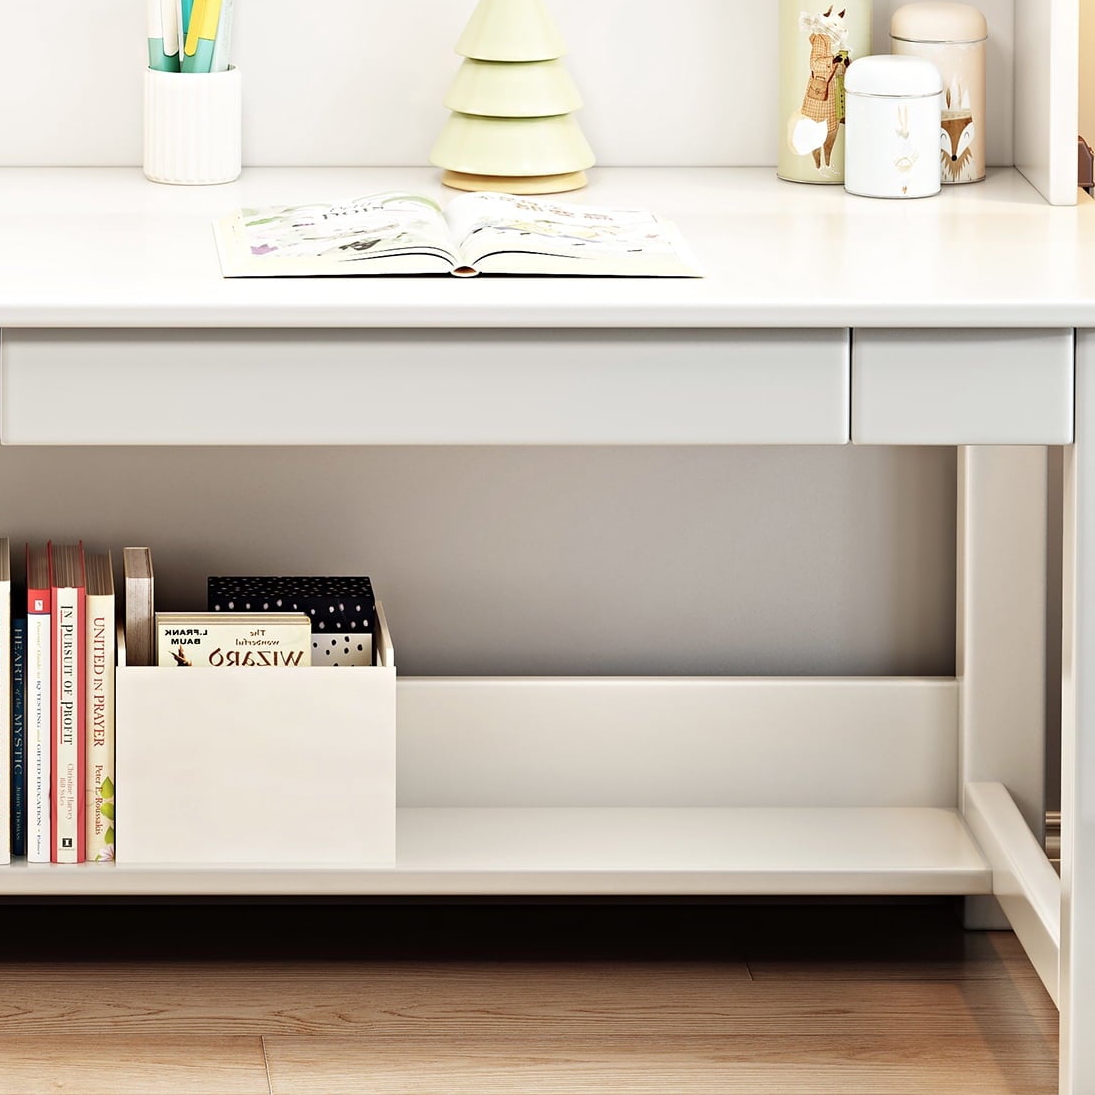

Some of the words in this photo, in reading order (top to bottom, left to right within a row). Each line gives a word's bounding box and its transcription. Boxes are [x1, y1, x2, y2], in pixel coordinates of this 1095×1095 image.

[13, 628, 22, 685] HEART
[60, 624, 74, 677] PURSUIT
[93, 617, 105, 675] UNITED
[62, 680, 74, 696] OF
[13, 713, 22, 776] MYSTIC
[60, 701, 74, 745] PROFIT
[93, 694, 105, 747] PRAYER
